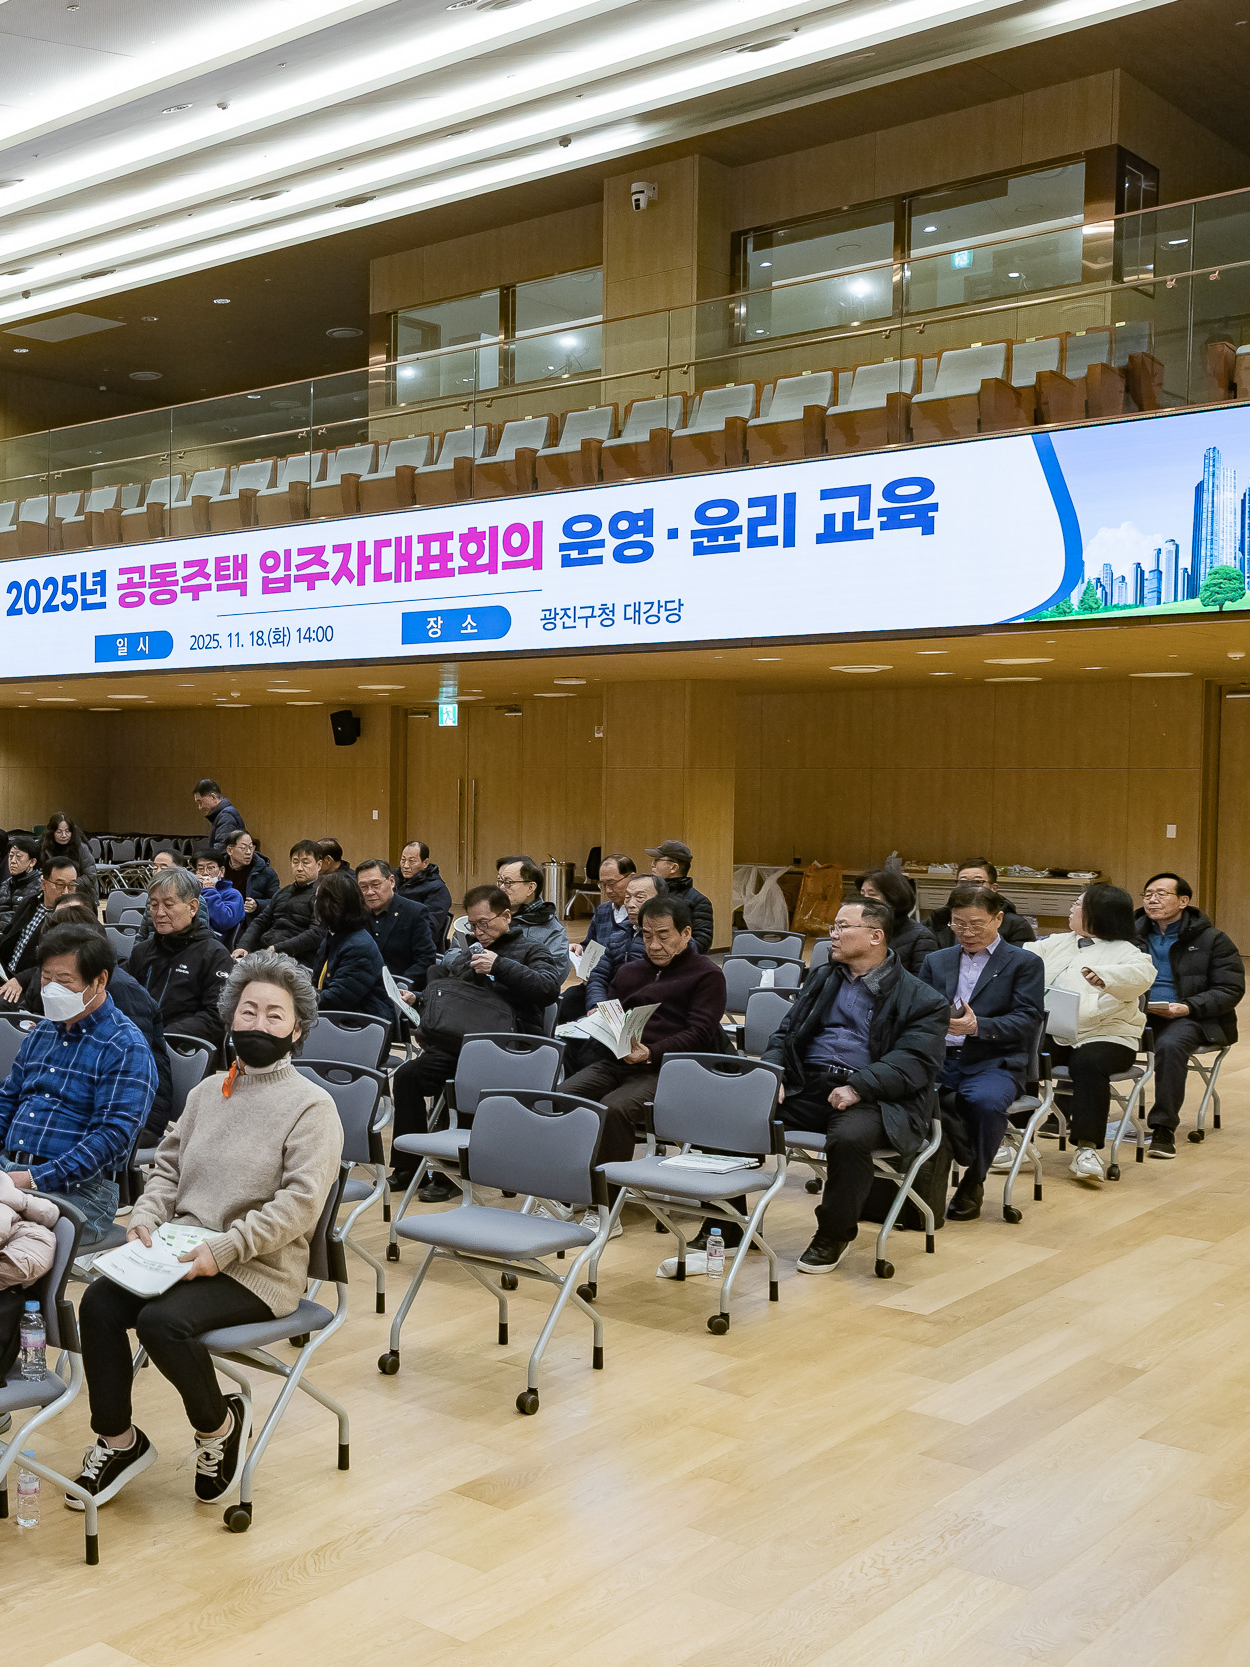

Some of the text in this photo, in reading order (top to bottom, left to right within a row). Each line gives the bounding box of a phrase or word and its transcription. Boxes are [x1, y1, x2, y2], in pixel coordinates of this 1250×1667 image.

[6, 569, 107, 617] 2025년
[116, 553, 248, 609] 공동주택
[259, 520, 544, 596] 입주자대표회의
[815, 476, 940, 545] 교육
[539, 598, 685, 632] 광진구청 대강당
[189, 633, 223, 651] 2025.
[296, 624, 334, 644] 14:00
